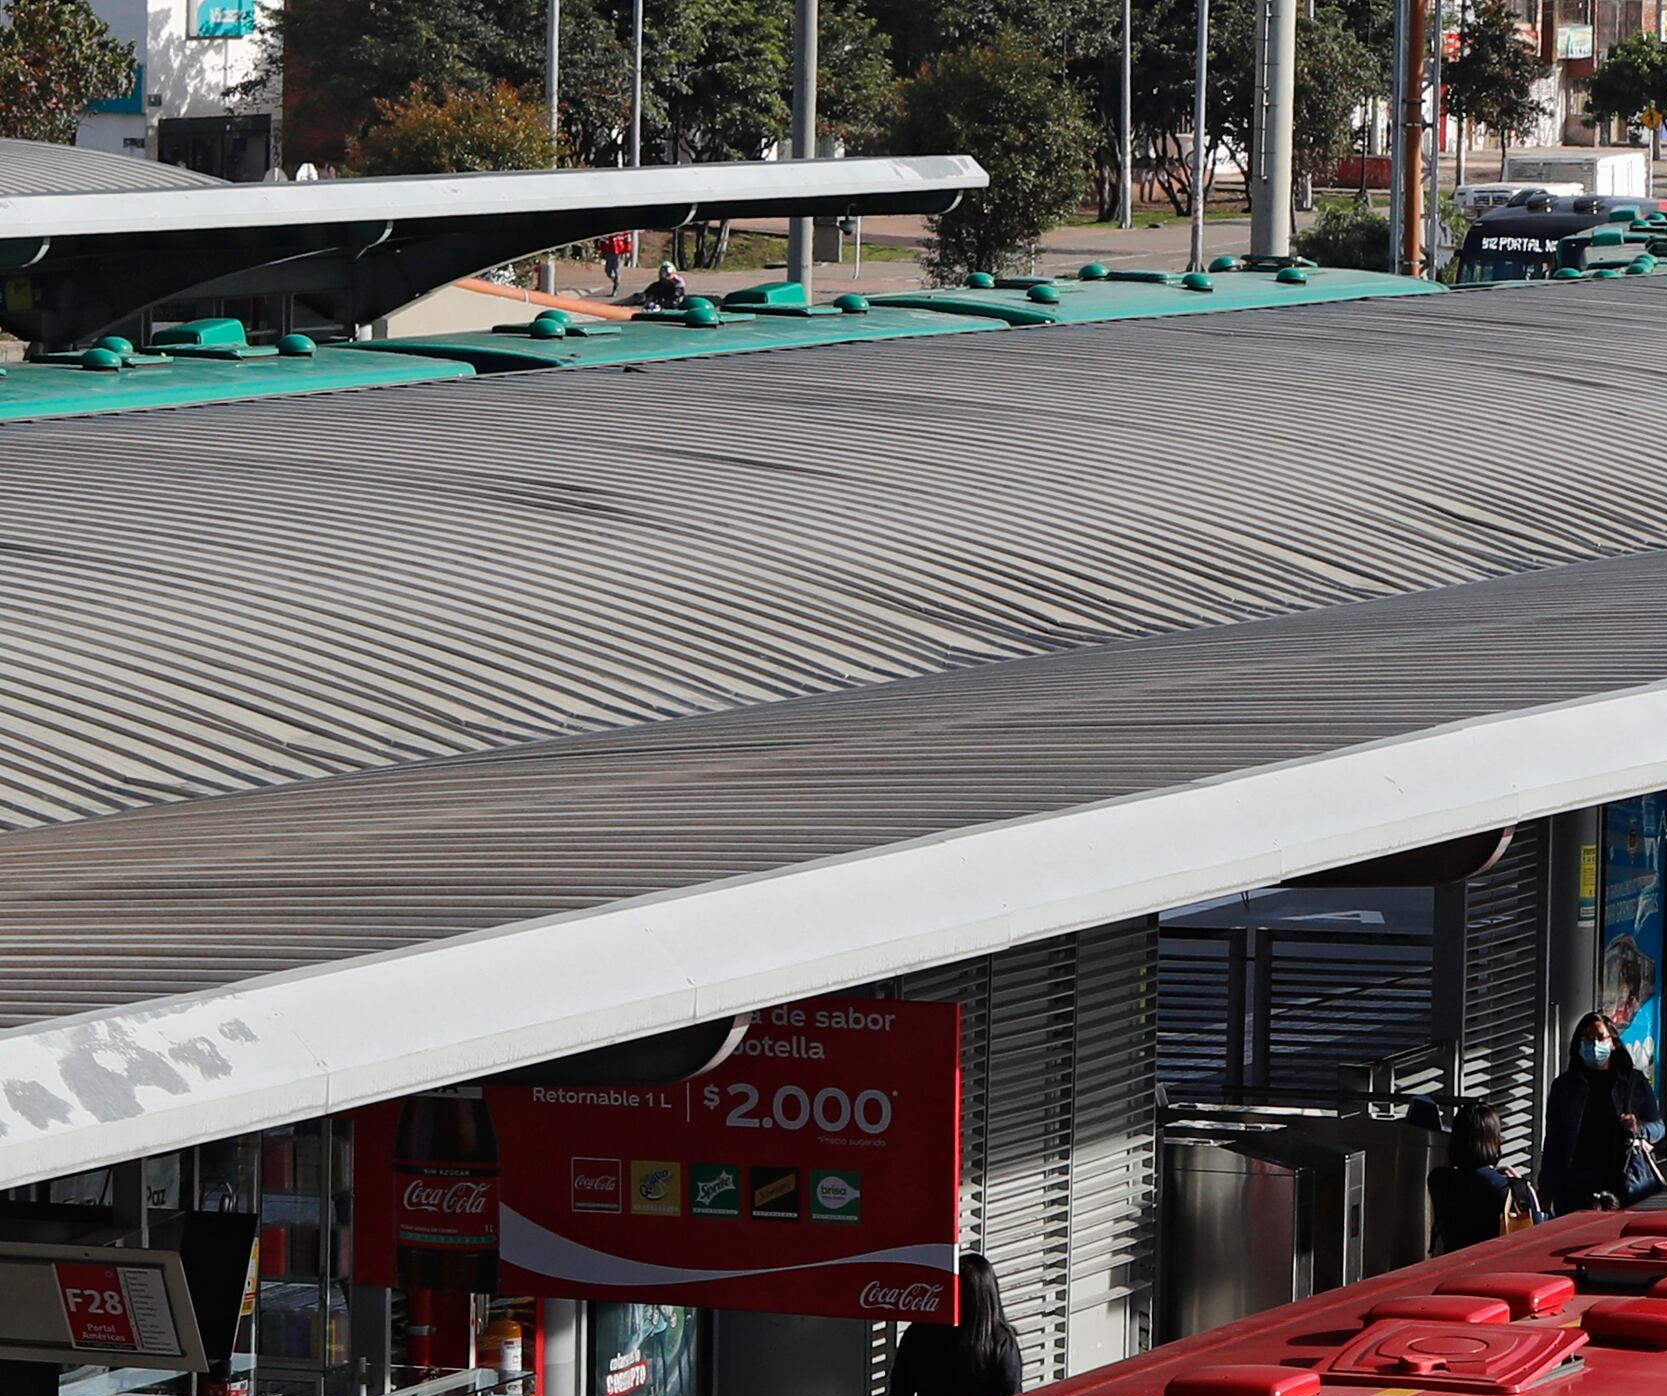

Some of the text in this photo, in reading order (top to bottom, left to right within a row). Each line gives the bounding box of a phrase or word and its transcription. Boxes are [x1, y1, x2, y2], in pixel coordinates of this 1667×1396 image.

[1499, 237, 1543, 252] PORTAL
[771, 1005, 806, 1027] de
[815, 1007, 895, 1031] sabor
[532, 1087, 640, 1107] Retornable
[403, 1179, 492, 1214] Coca-Cola
[65, 1288, 123, 1315] F28
[859, 1279, 944, 1314] Coca-Cola
